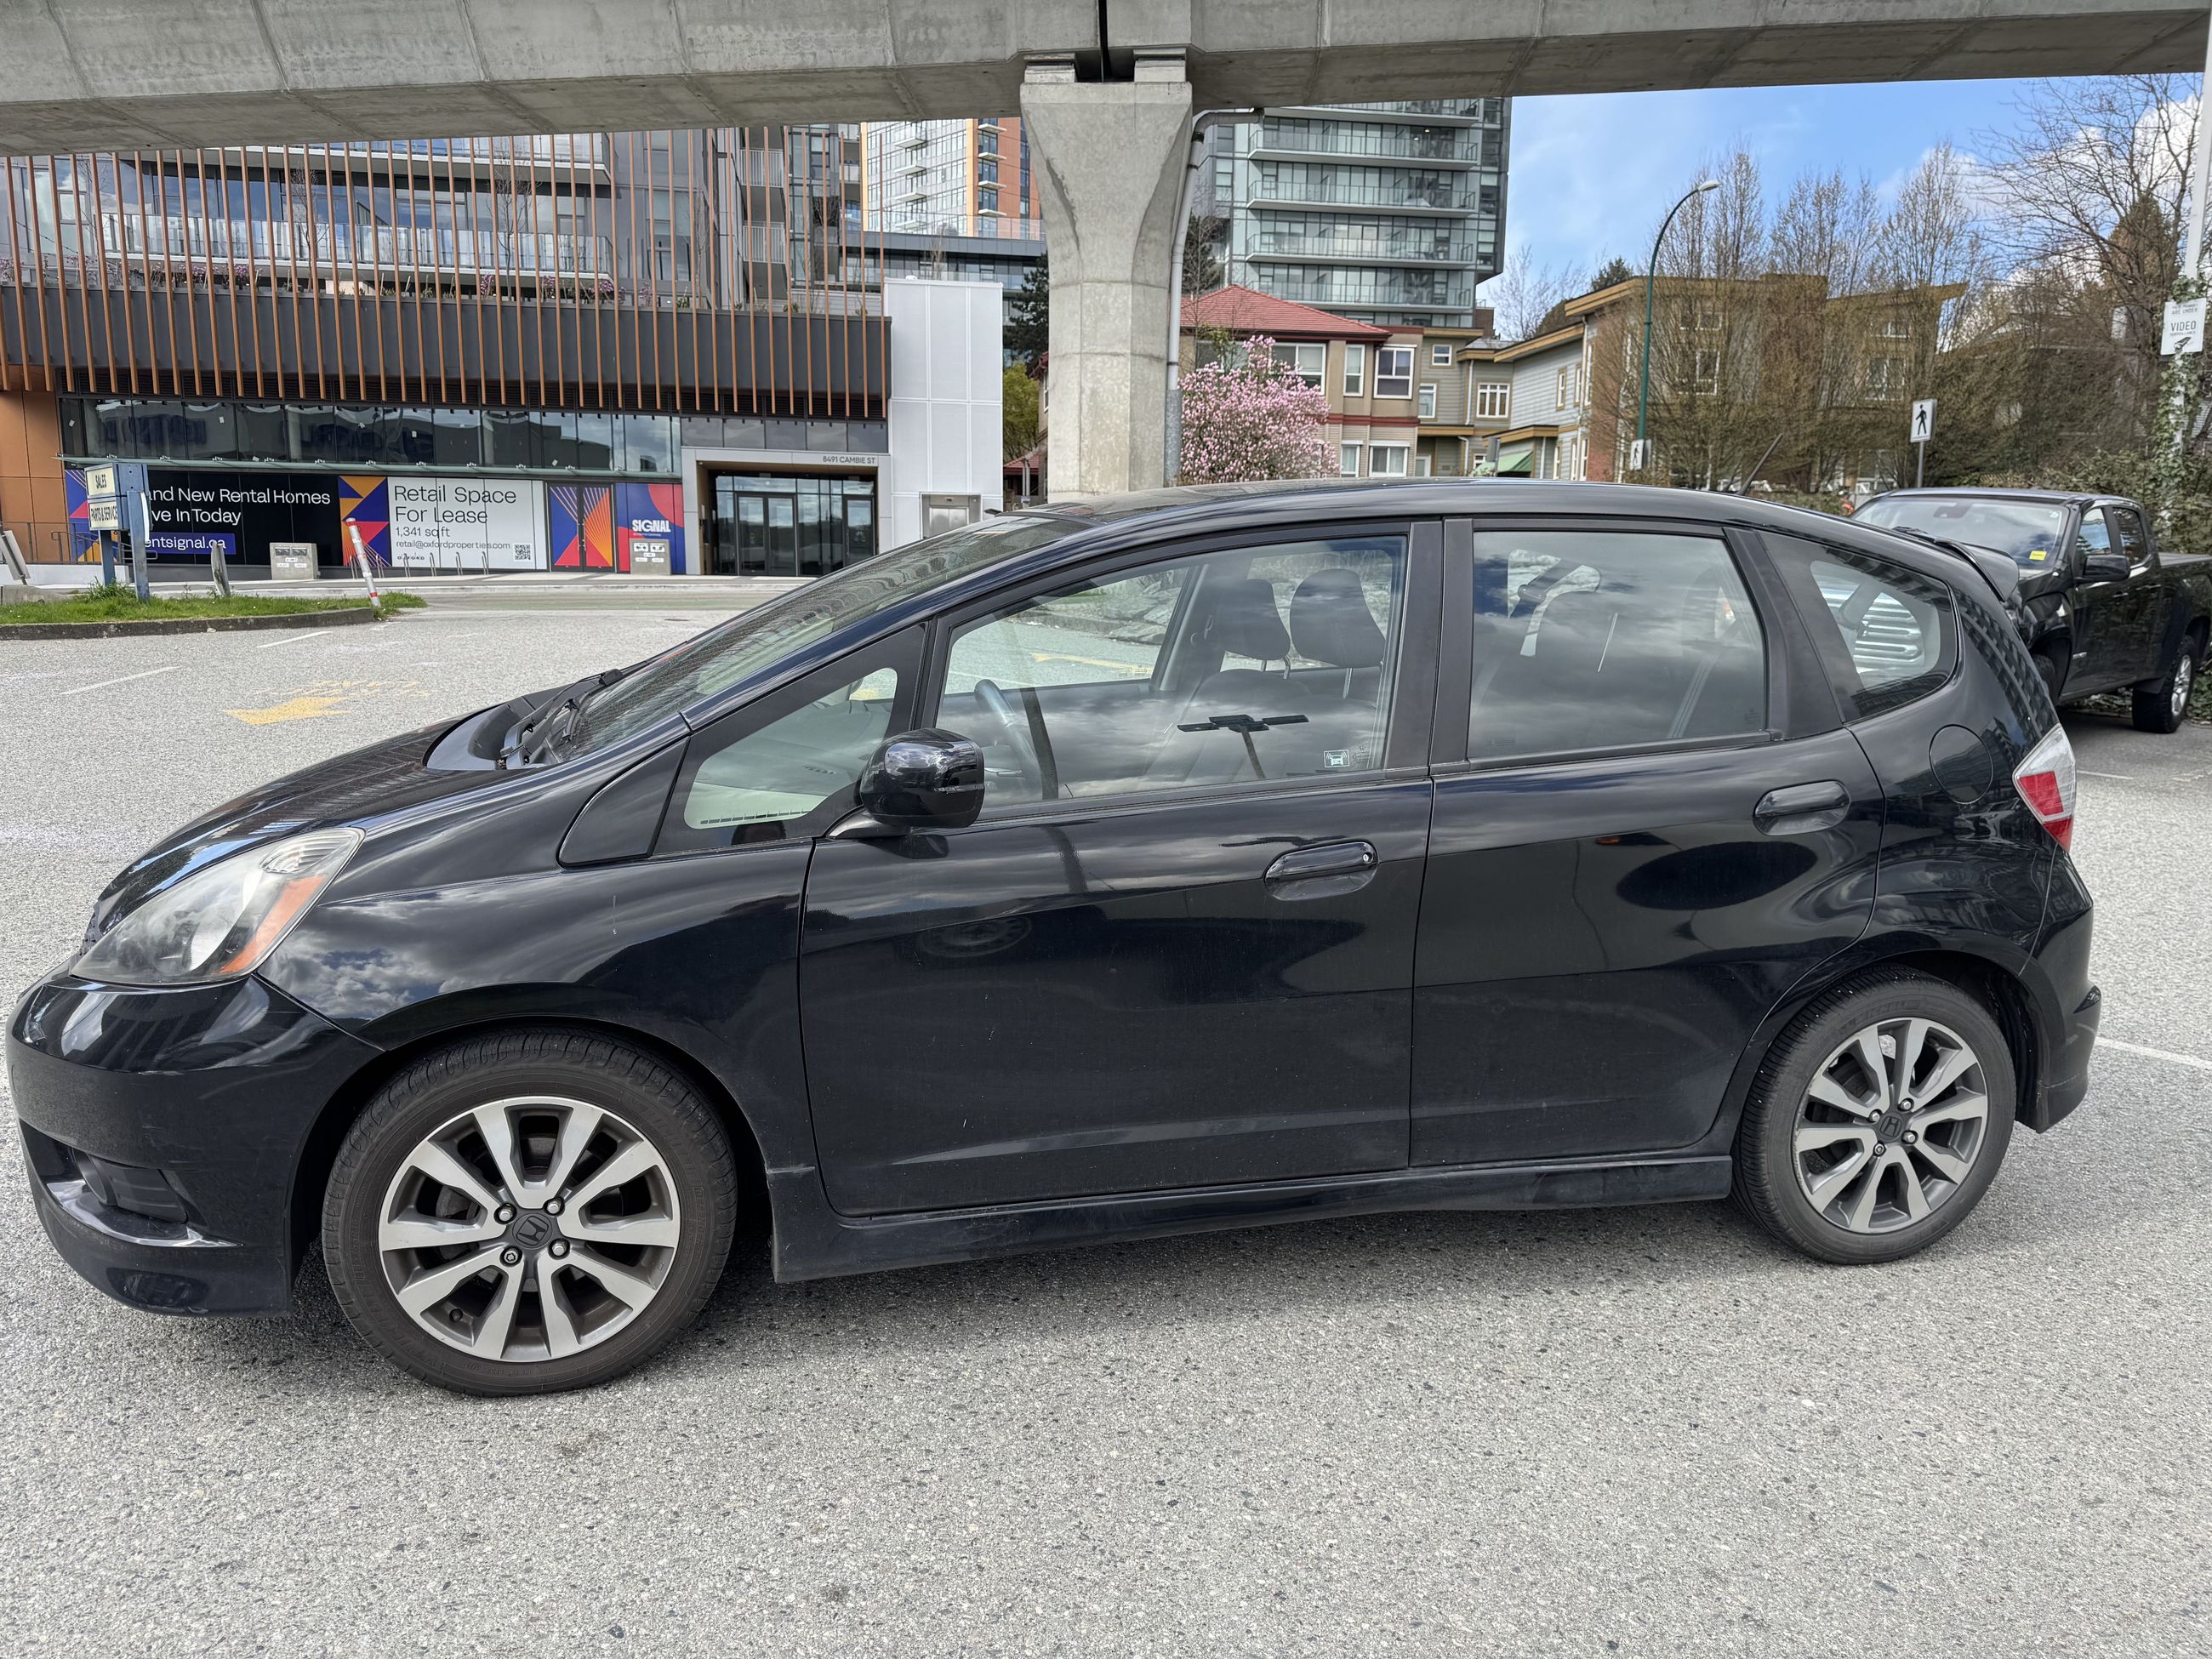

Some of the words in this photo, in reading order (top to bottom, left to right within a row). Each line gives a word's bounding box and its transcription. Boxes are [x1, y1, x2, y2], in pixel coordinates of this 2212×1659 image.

[2170, 320, 2197, 332] VIDEO
[95, 473, 107, 489] SALES
[178, 487, 215, 503] New
[219, 487, 271, 503] Rental
[273, 489, 331, 505] Homes
[394, 484, 447, 502] Retail
[454, 486, 516, 506] Space
[176, 508, 191, 522] In
[191, 507, 242, 526] Today
[396, 506, 427, 522] For
[434, 506, 487, 524] Lease
[396, 526, 421, 537] 1,341
[425, 528, 439, 539] sq
[441, 526, 450, 537] ft
[632, 519, 671, 533] SIGNAL
[145, 535, 226, 550] entsignal.ca
[396, 539, 510, 550] retail@oxfordproperties.com
